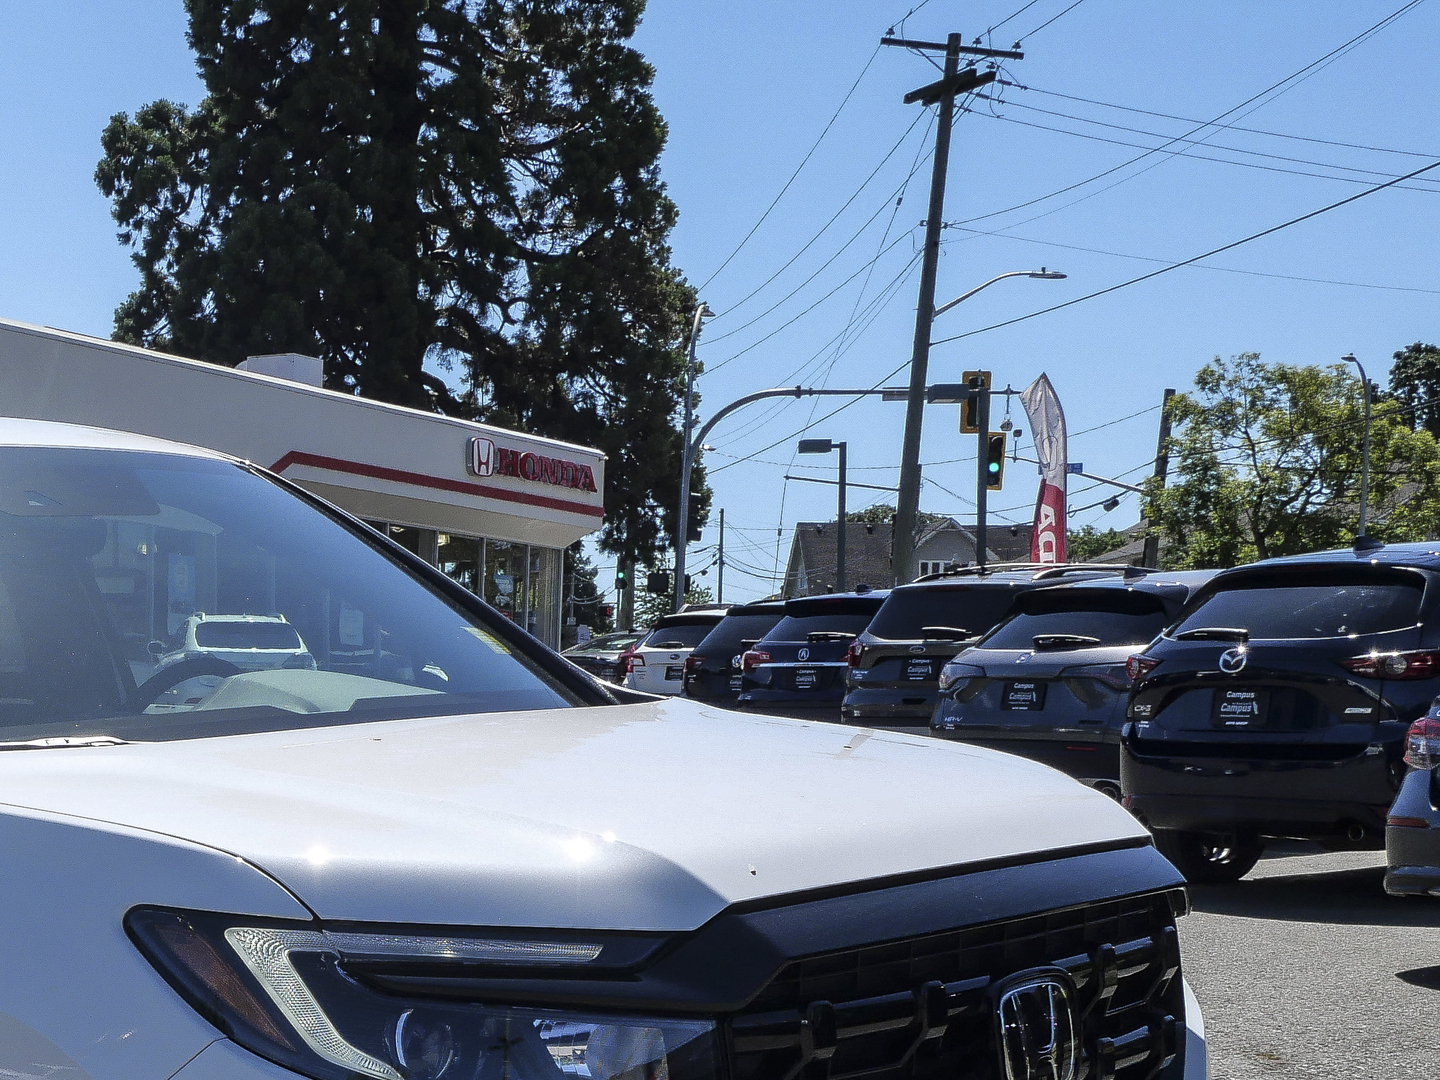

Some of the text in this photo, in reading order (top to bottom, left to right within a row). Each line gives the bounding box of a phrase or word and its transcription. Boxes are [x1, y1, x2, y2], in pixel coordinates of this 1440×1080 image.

[497, 447, 597, 493] HONDA
[1226, 691, 1255, 699] Campus
[1221, 702, 1252, 714] Campus
